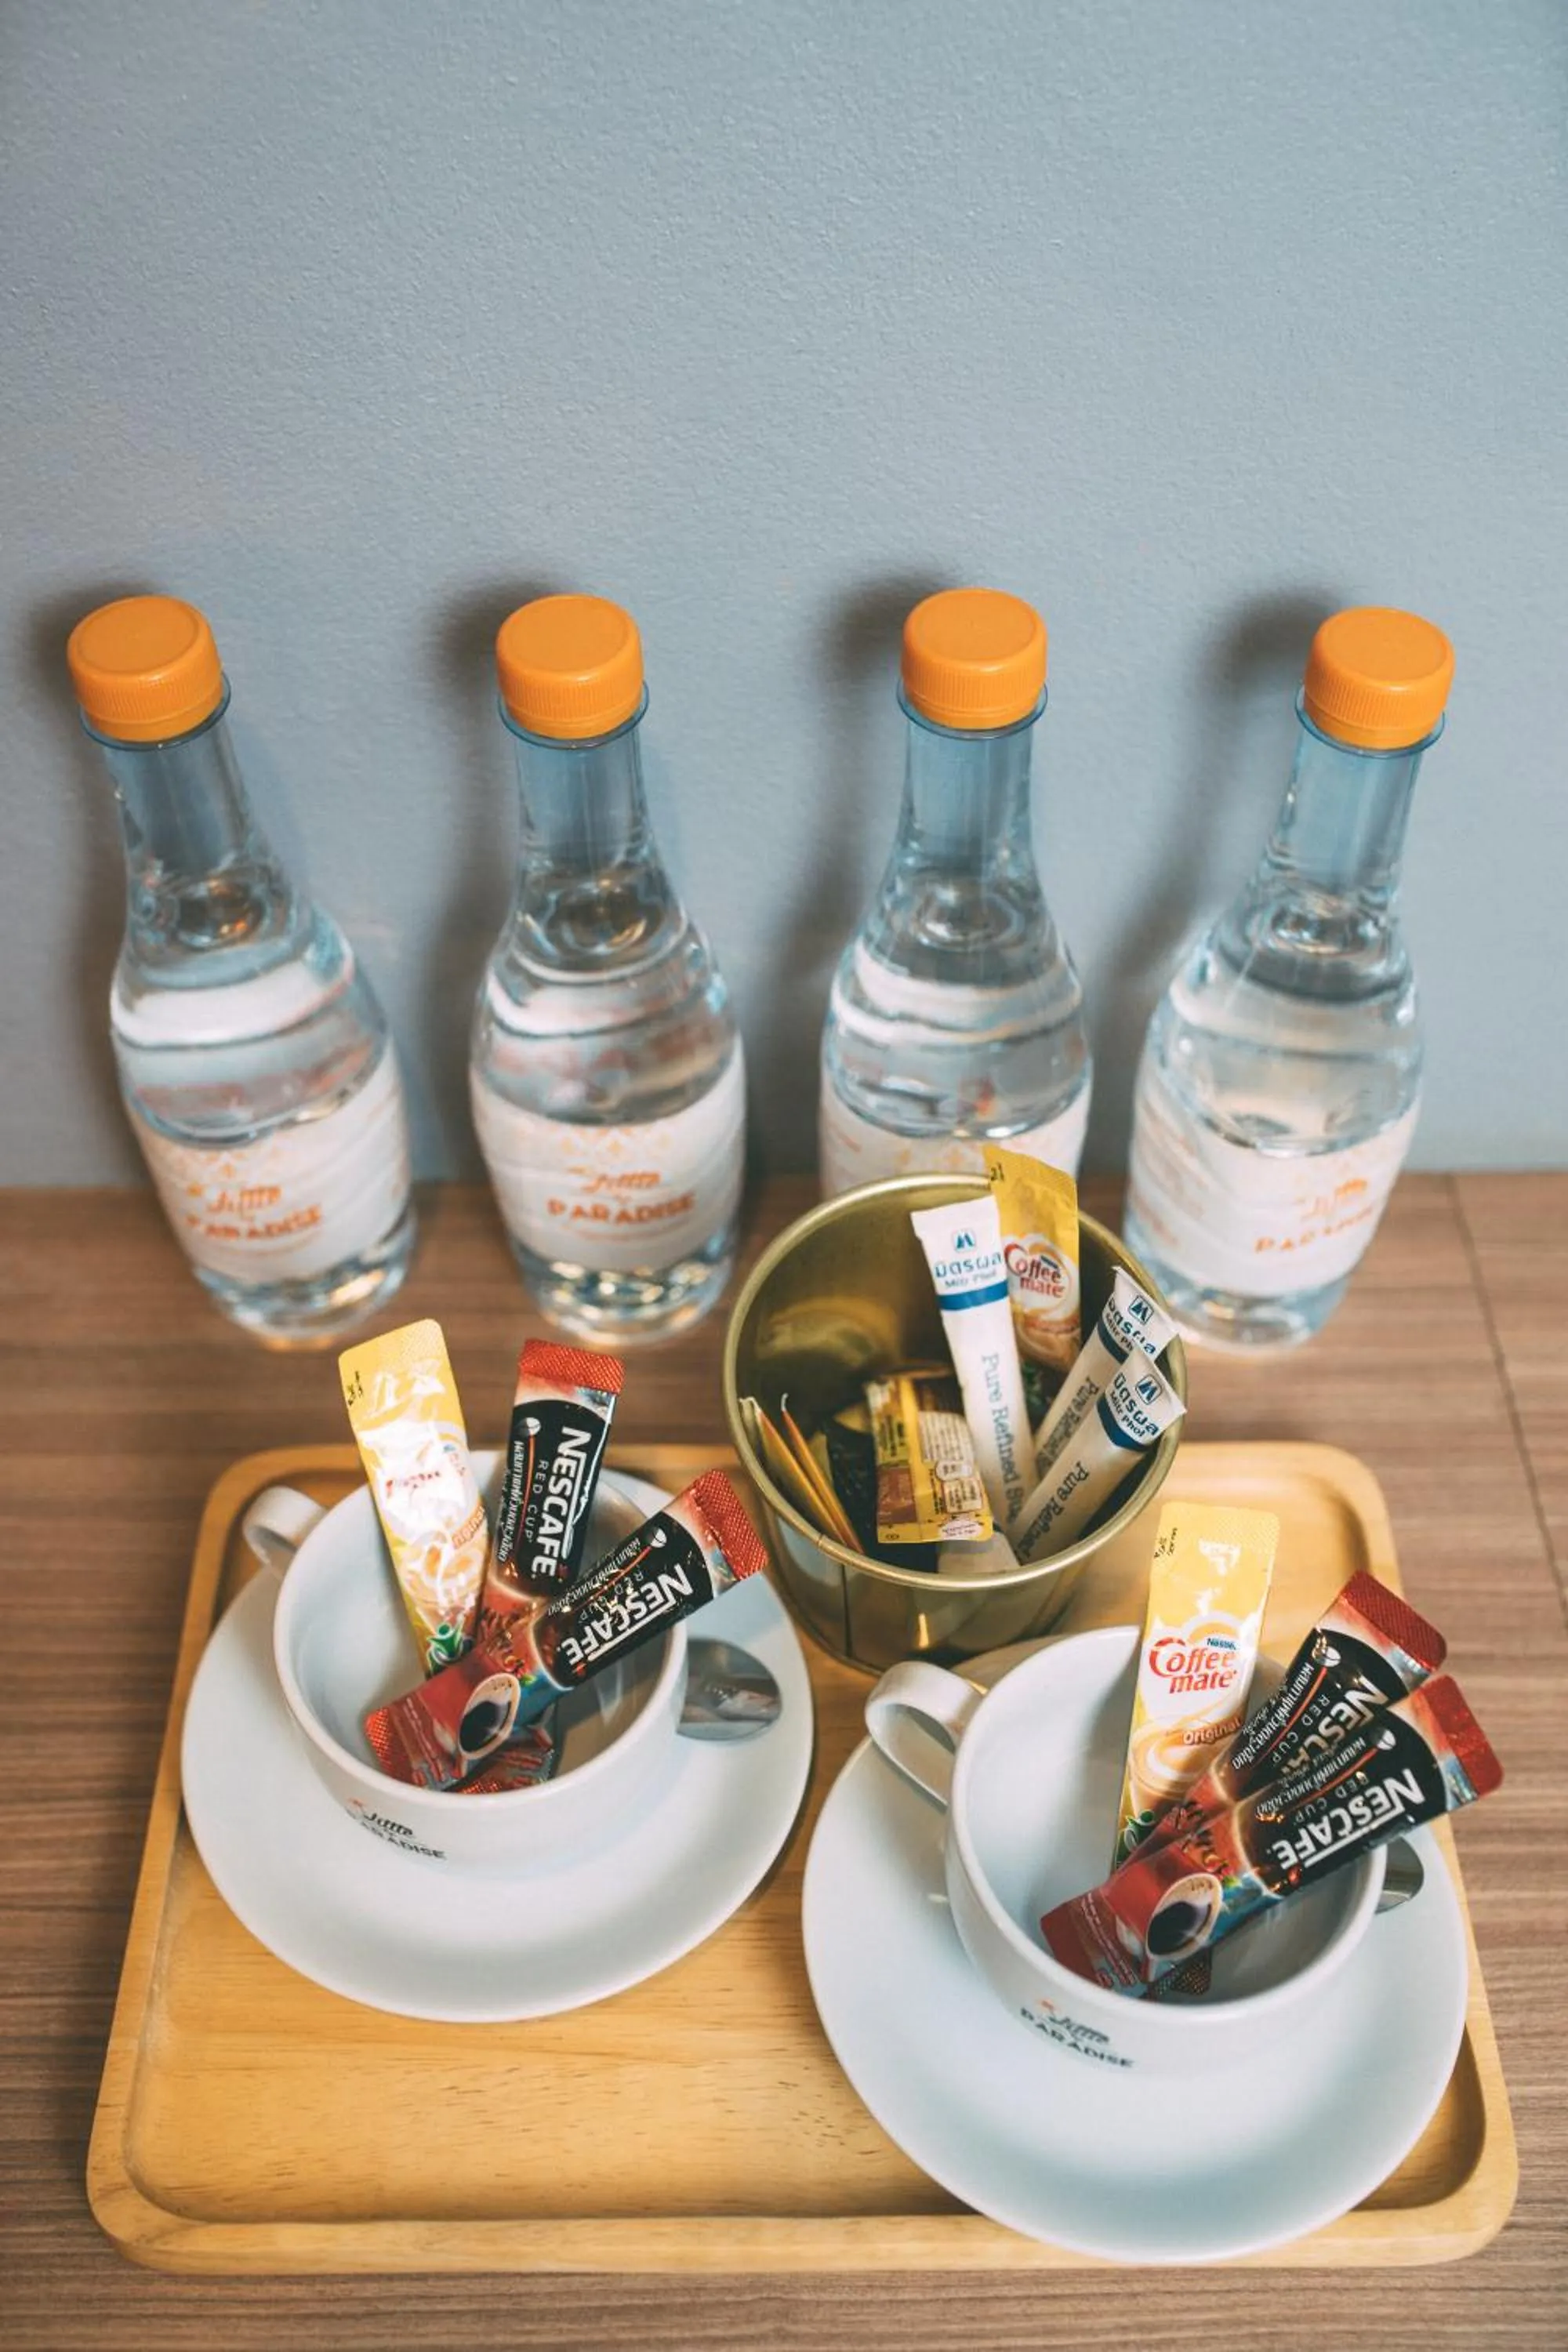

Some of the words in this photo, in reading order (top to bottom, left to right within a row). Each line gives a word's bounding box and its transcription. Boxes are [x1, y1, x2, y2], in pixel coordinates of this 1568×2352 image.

[1004, 1243, 1061, 1283] Coffee
[1020, 1277, 1065, 1298] mate
[1120, 1336, 1134, 1352] Ph
[1071, 1377, 1099, 1409] Pure
[982, 1352, 1003, 1403] Pure
[993, 1408, 1018, 1483] Refined
[1110, 1391, 1123, 1414] Mitr
[1121, 1415, 1146, 1437] Phol
[532, 1459, 549, 1494] RED
[1058, 1461, 1090, 1501] Pure
[525, 1504, 538, 1542] CUP
[1018, 1501, 1065, 1559] Refined
[1149, 1637, 1236, 1678] Coffee
[1169, 1670, 1234, 1693] mate
[1301, 1694, 1330, 1726] RED
[1272, 1732, 1298, 1763] CUP
[1295, 1798, 1327, 1824] CUP
